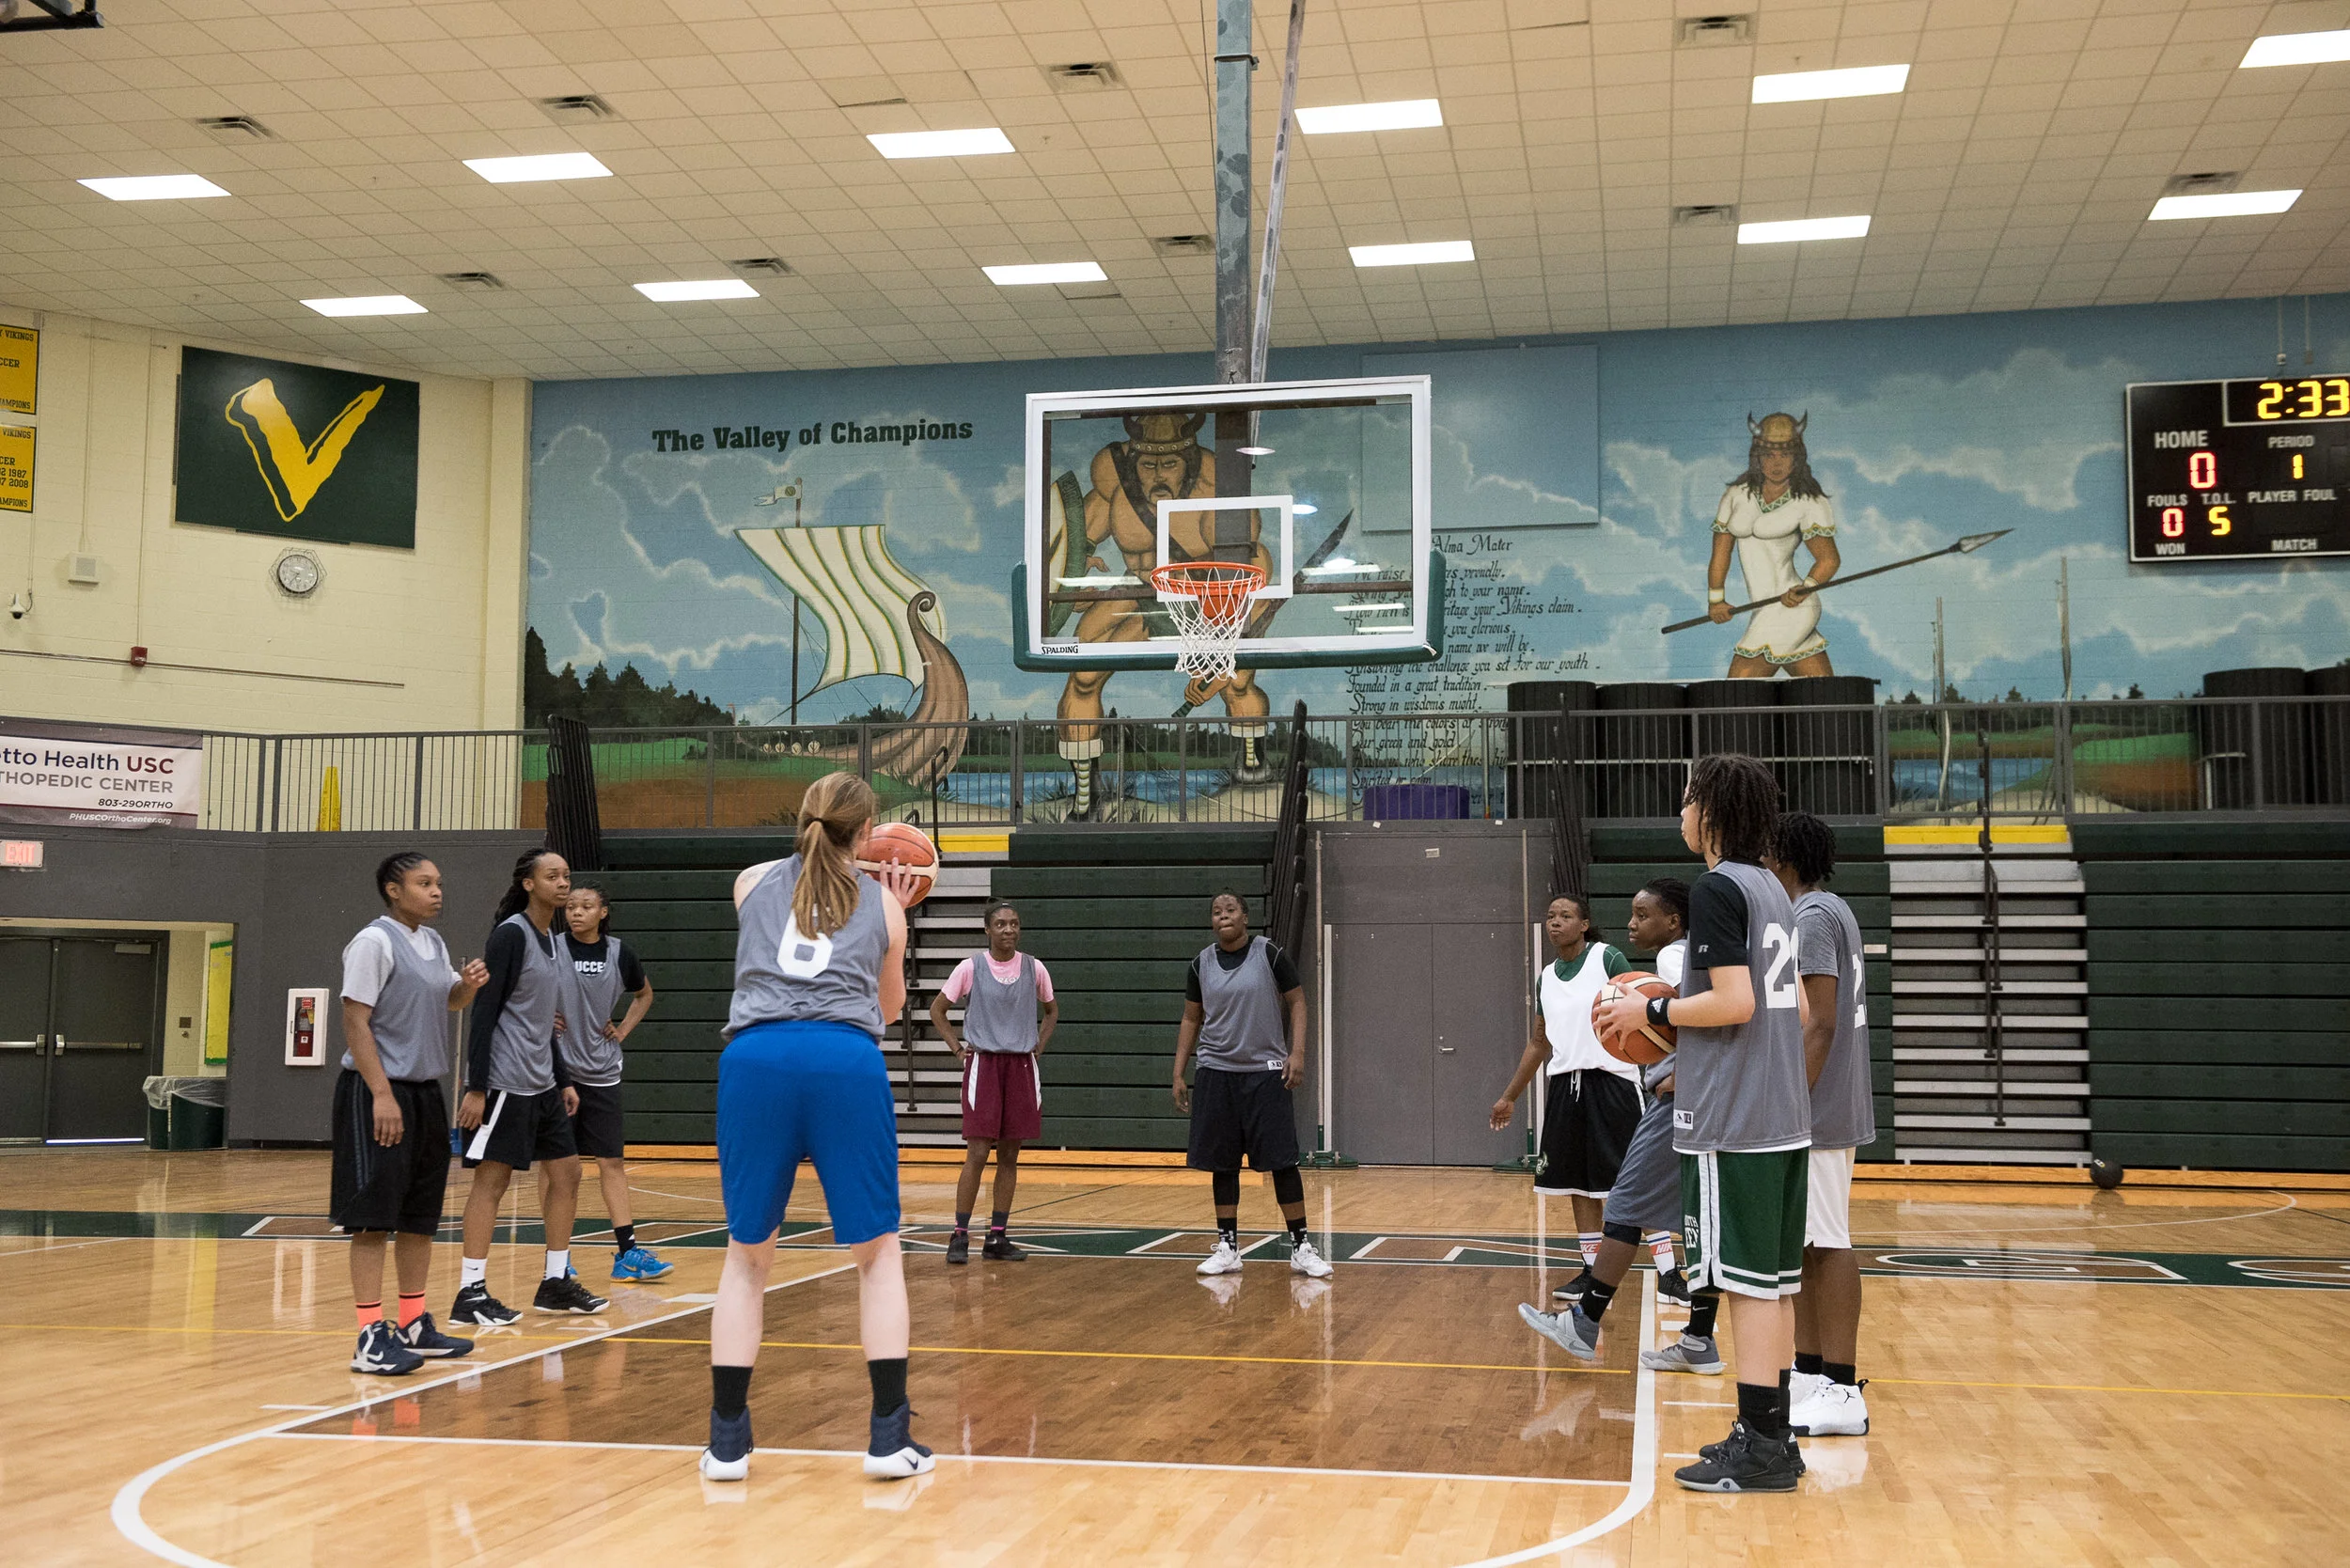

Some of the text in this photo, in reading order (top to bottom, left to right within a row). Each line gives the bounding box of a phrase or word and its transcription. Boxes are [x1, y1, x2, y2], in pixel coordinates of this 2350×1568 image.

[5, 330, 34, 341] VIKINGS
[2257, 380, 2350, 419] 2:33
[3, 429, 31, 439] VIKINGS
[652, 418, 974, 452] The Valley of Champions
[2154, 431, 2208, 448] HOME
[2267, 435, 2315, 448] PERIOD
[8, 468, 26, 478] 1987
[2189, 451, 2217, 489] 0
[2292, 453, 2304, 479] 1
[9, 479, 28, 488] 2008
[2147, 494, 2188, 508] FOULS
[2201, 493, 2237, 505] T.O.L.
[2248, 489, 2337, 504] PLAYER FOUL
[2162, 508, 2184, 537] 0
[2208, 506, 2232, 536] 5
[1432, 534, 1513, 556] Alma Mater
[2155, 542, 2186, 555] WON
[2271, 539, 2317, 551] MATCH
[1470, 604, 1496, 619] your
[1496, 596, 1543, 618] Vikings
[1448, 624, 1467, 637] you
[1042, 645, 1078, 654] SPALDING
[1448, 643, 1473, 653] name
[1496, 635, 1516, 652] will
[1427, 654, 1470, 675] challenge
[1471, 662, 1491, 675] you
[1496, 656, 1511, 671] set
[1513, 654, 1533, 671] for
[1535, 660, 1554, 670] our
[1346, 674, 1387, 693] Founded
[1390, 678, 1400, 692] in
[1405, 682, 1412, 692] a
[1414, 676, 1439, 695] great
[1349, 693, 1386, 714] Strong
[1389, 697, 1399, 712] in
[1408, 731, 1428, 749] and
[0, 748, 174, 774] tto Health USC
[100, 777, 174, 793] CENTER
[98, 798, 173, 809] 803-29ORTHO
[6, 842, 35, 864] EXIT
[776, 903, 834, 979] 6
[574, 961, 606, 972] UCCE
